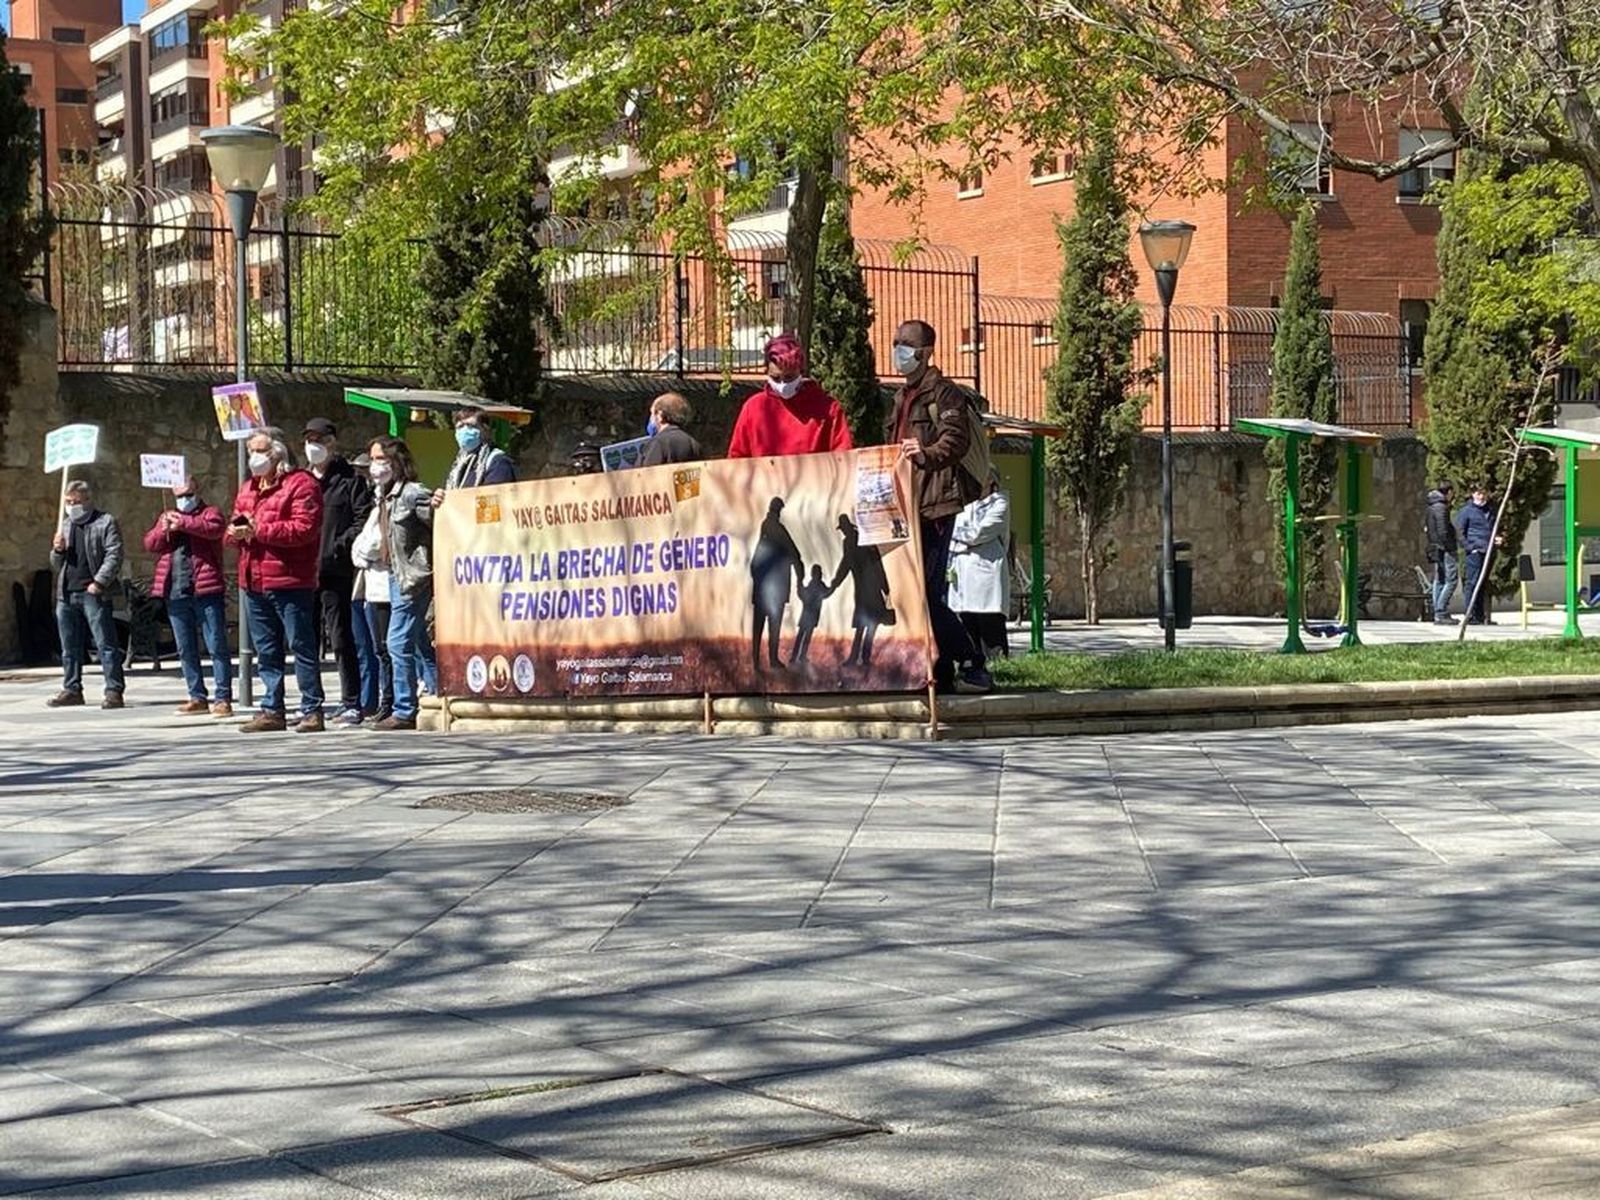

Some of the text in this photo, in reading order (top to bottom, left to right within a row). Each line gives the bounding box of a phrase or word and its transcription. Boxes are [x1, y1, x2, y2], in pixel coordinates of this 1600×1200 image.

[544, 500, 588, 525] GAITAS
[591, 492, 673, 522] SALAMANCA
[454, 532, 730, 585] CONTRA LA BRECHA DE GÉNERO
[501, 582, 677, 621] PENSIONES DIGNAS
[628, 671, 673, 683] Salamanca
